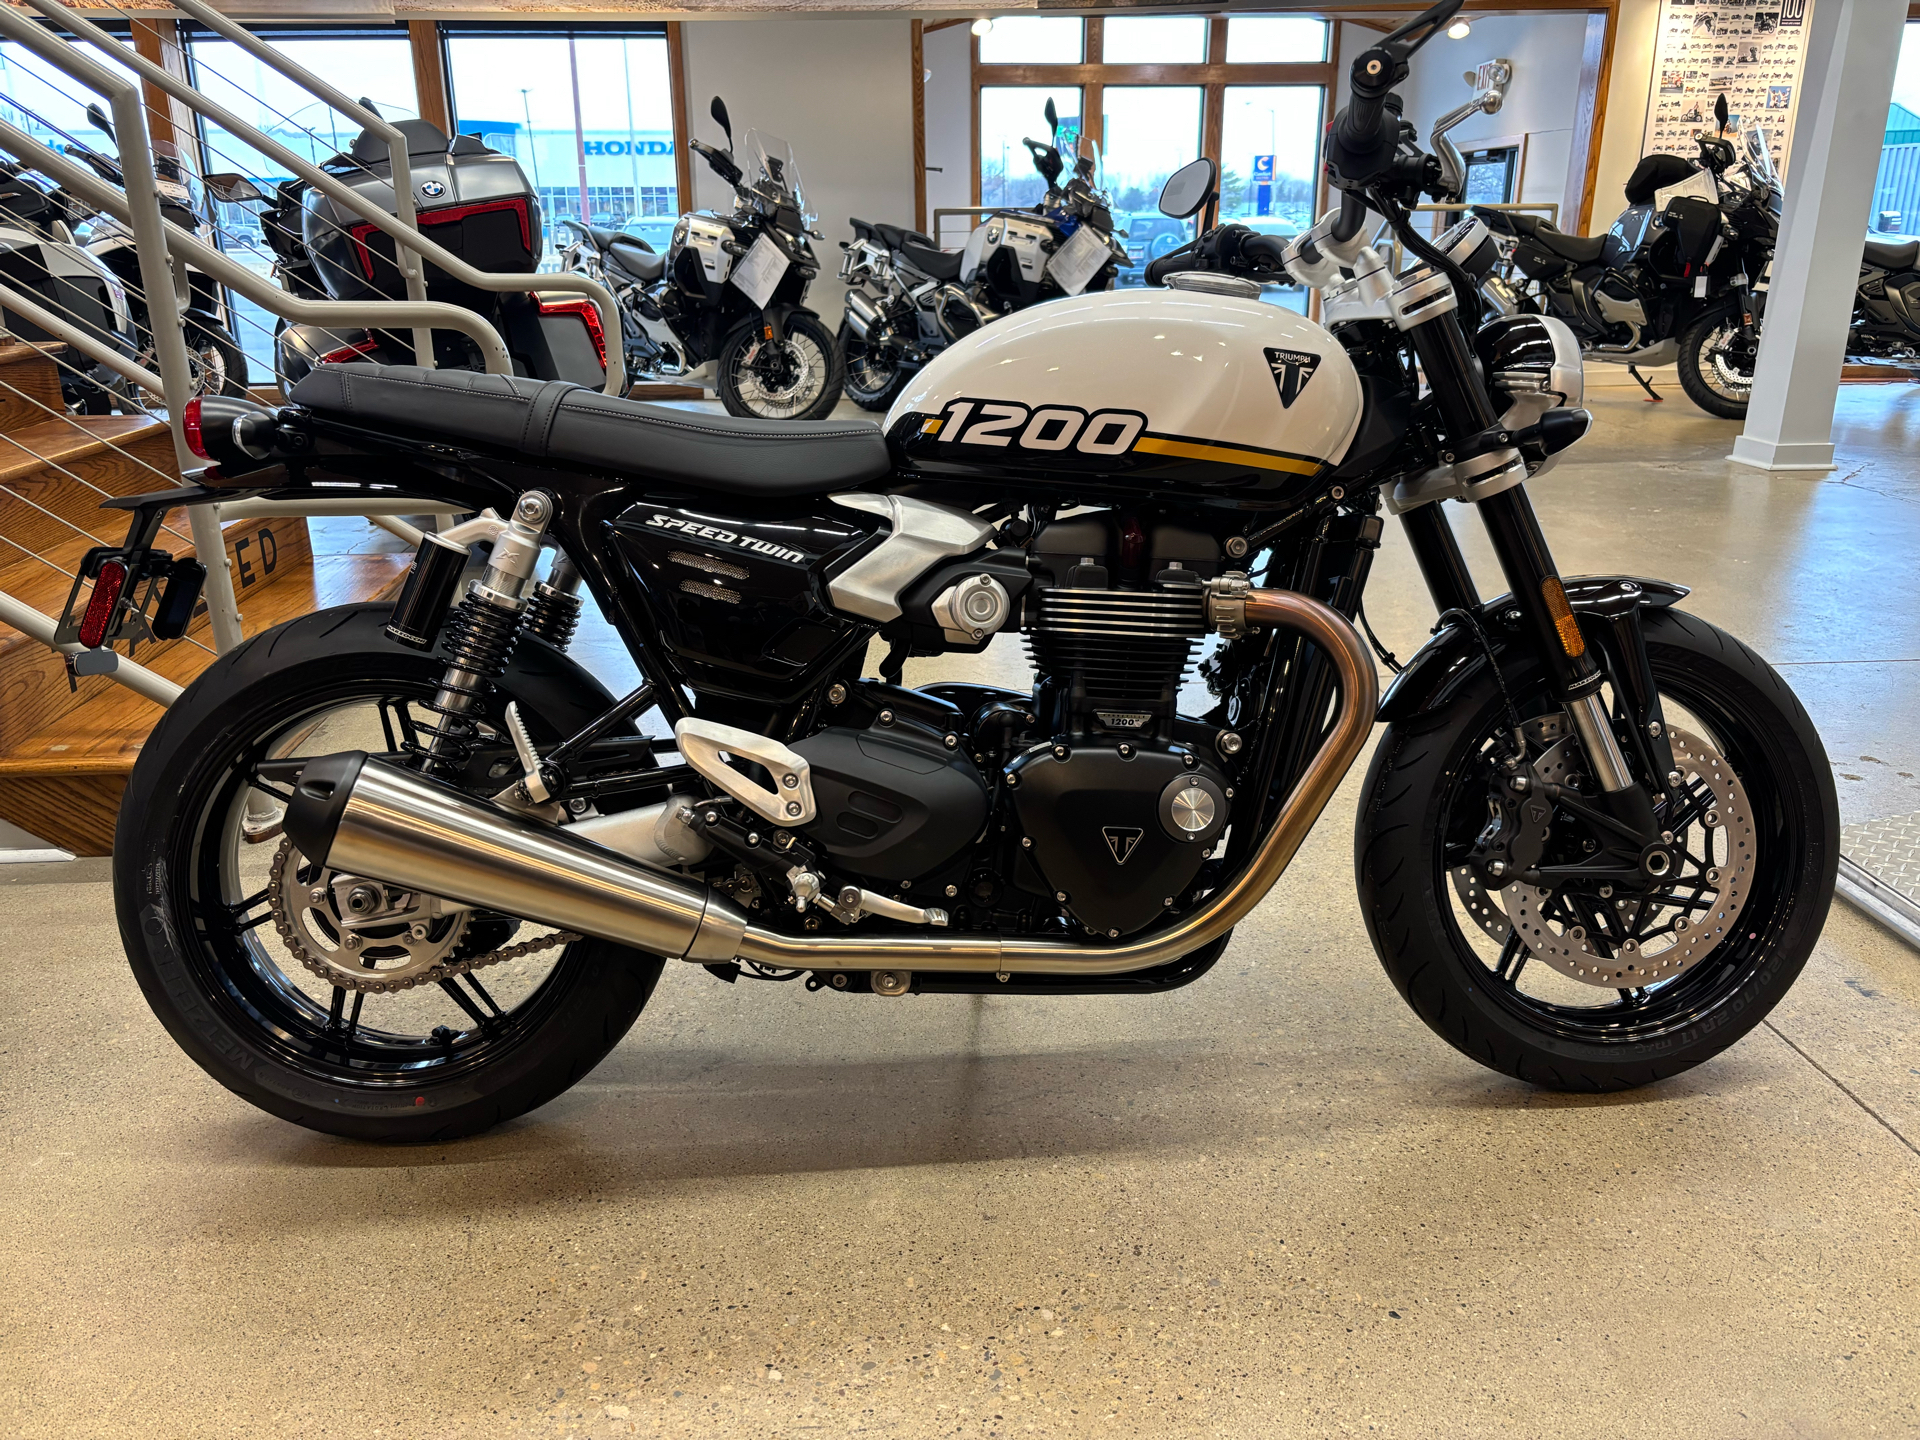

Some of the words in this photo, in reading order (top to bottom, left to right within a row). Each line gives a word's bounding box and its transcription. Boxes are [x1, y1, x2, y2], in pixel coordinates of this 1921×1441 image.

[1477, 63, 1492, 91] EXI
[1274, 351, 1311, 363] TRIUMPH
[938, 402, 1144, 455] 1200
[645, 514, 738, 543] SPEED
[739, 535, 805, 563] TWIN
[1731, 951, 1787, 1014] 120/70
[153, 950, 256, 1072] METZELER
